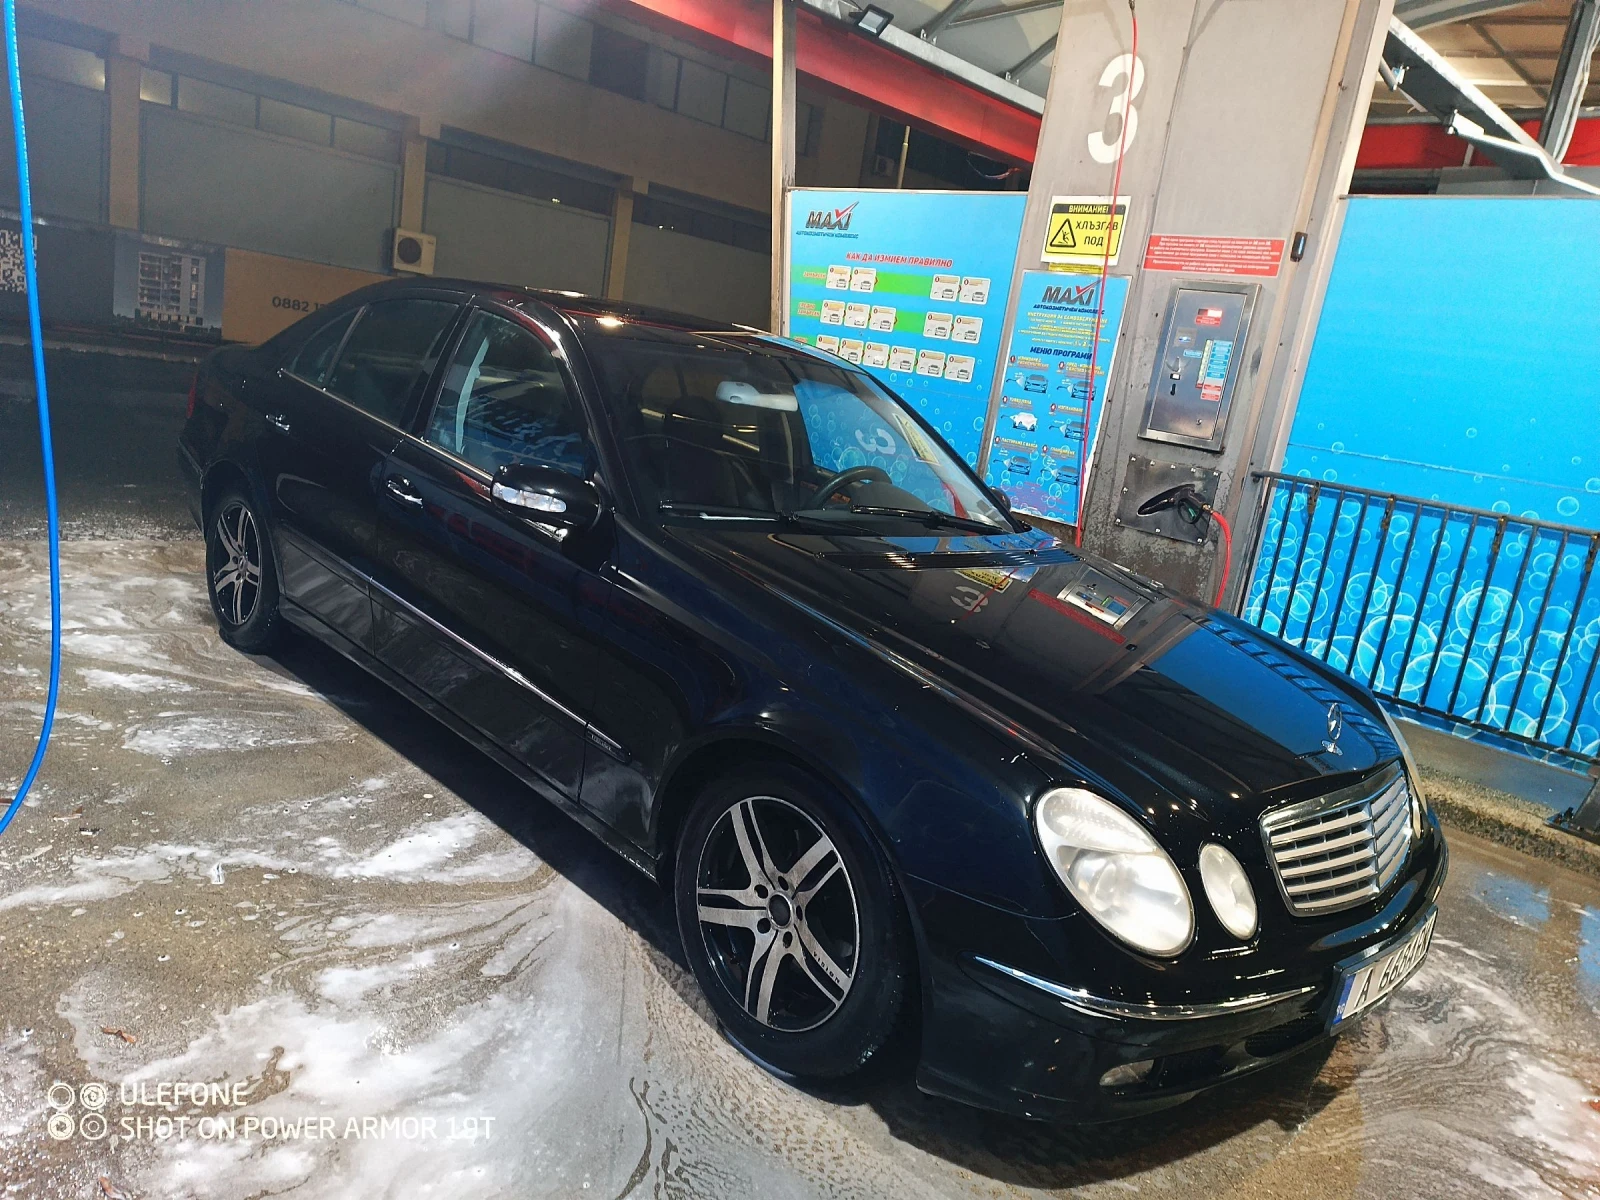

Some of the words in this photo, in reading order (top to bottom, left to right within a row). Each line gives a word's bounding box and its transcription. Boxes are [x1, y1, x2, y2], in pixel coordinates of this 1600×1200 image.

[1087, 53, 1145, 164] 3
[1068, 204, 1109, 214] ВНИМАНИЕ!
[805, 206, 856, 230] MAXI
[1075, 220, 1119, 231] ХЛЪЗГАВ
[1083, 235, 1104, 247] ПОД
[846, 252, 861, 261] КАК
[861, 253, 873, 263] ДА
[874, 253, 908, 265] ИЗМИЕМ
[908, 255, 953, 268] ПРАВИЛНО
[1042, 283, 1097, 306] MAXI
[271, 296, 309, 312] 0882
[1030, 346, 1053, 355] МЕНЮ
[1053, 347, 1093, 360] ПРОГРАМИ
[813, 951, 840, 984] VISION
[1354, 966, 1374, 1009] A
